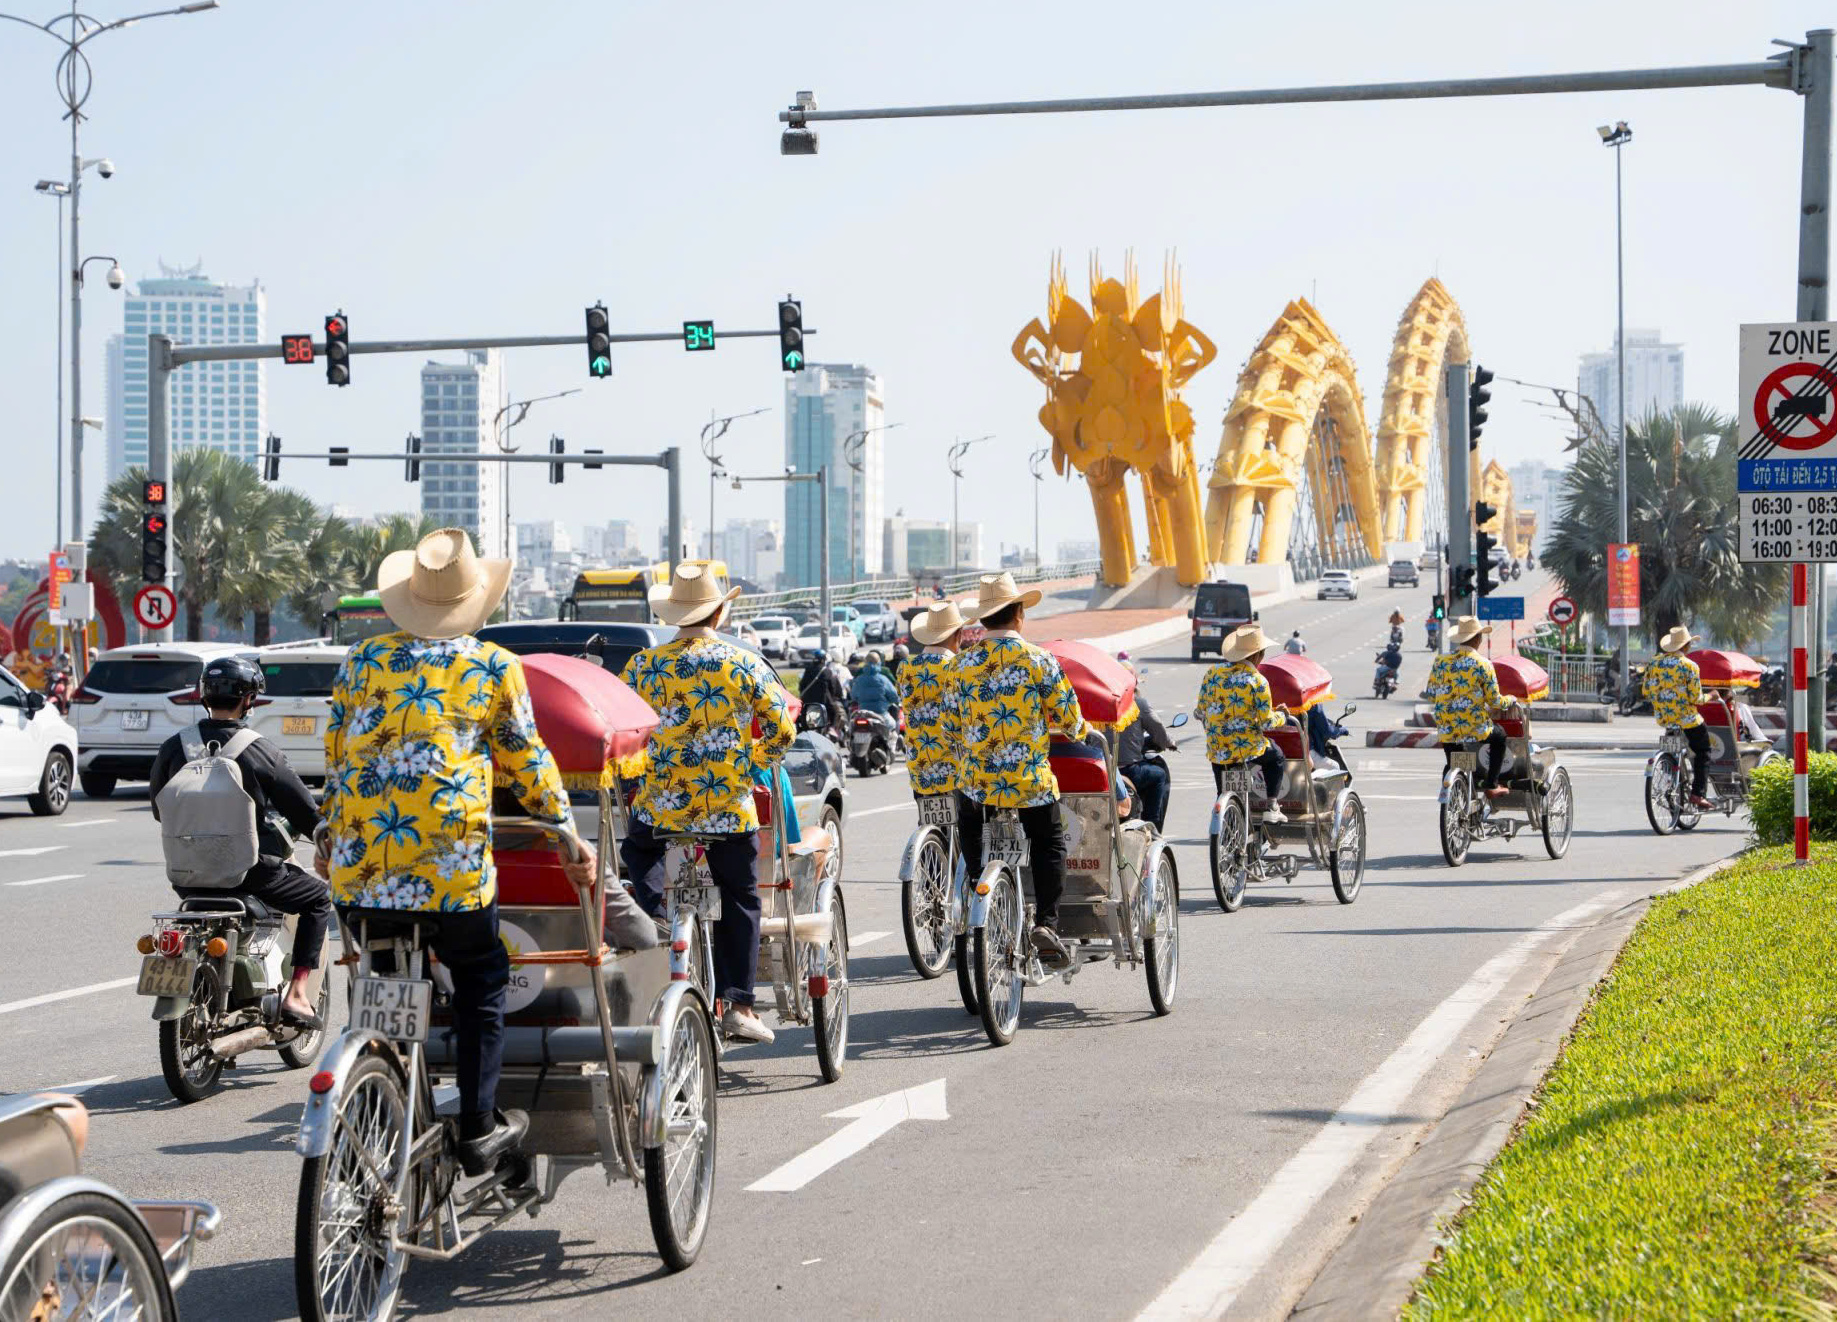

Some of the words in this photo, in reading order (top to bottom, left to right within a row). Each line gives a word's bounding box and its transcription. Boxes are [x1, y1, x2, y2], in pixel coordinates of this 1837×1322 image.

[686, 325, 713, 348] 34
[1768, 329, 1831, 355] ZONE
[285, 339, 312, 361] 38
[1814, 466, 1828, 488] 2,5
[1752, 497, 1792, 515] 06:30
[1752, 518, 1792, 537] 11:00
[1752, 540, 1792, 558] 16:00
[1225, 781, 1248, 792] 0025
[923, 798, 950, 812] HC-XL
[924, 811, 952, 825] 0030
[990, 839, 1022, 852] HC-XL
[362, 981, 417, 1010] HC-XL
[360, 1008, 417, 1037] 0056
